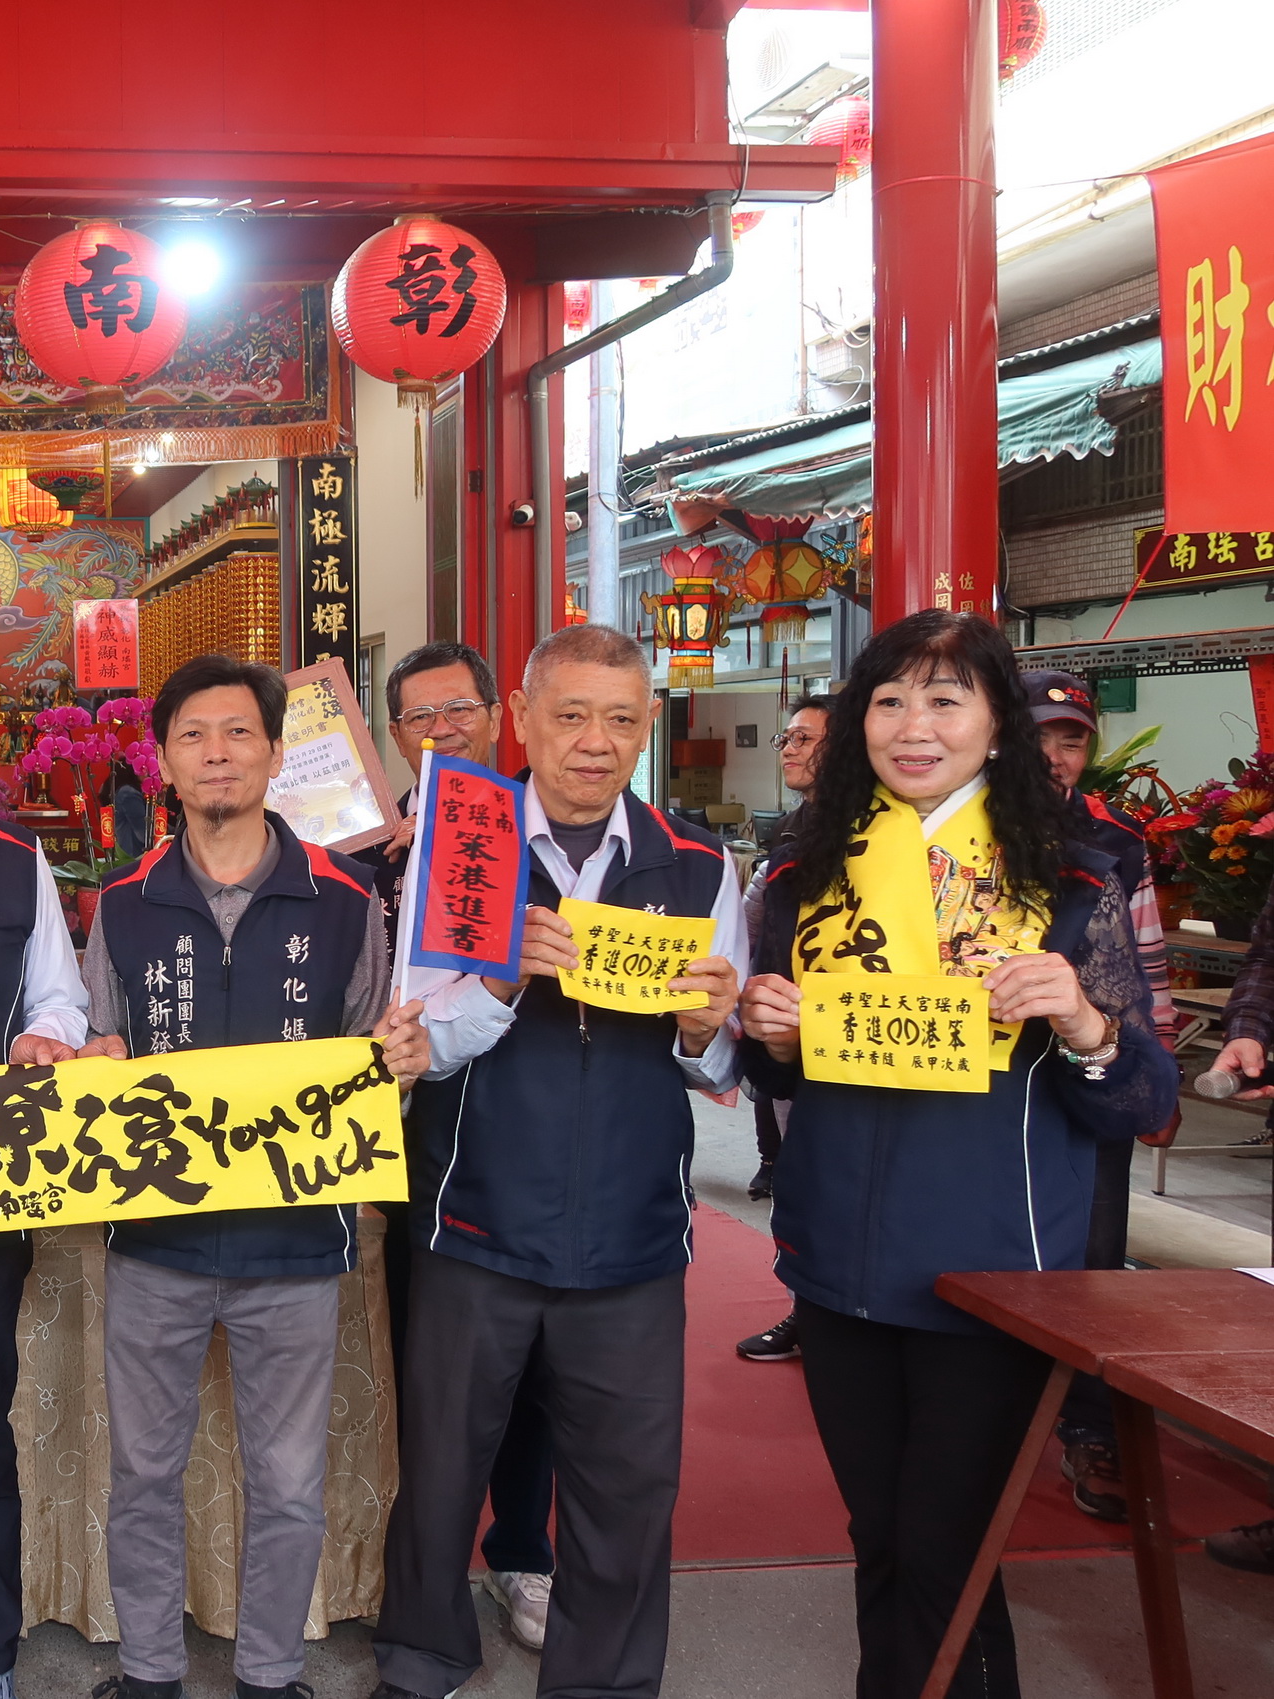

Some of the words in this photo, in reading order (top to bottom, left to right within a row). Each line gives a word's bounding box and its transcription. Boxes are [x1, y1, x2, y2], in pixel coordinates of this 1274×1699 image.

[63, 244, 160, 337] 南
[385, 244, 476, 338] 彰
[1185, 245, 1274, 433] 財
[309, 463, 350, 665] 南極流輝
[440, 830, 500, 952] 笨港進香
[175, 934, 194, 1043] 顧問團團長
[281, 934, 310, 1041] 彰化媽
[180, 1096, 300, 1169] You
[296, 1041, 395, 1140] good
[262, 1117, 400, 1204] luck
